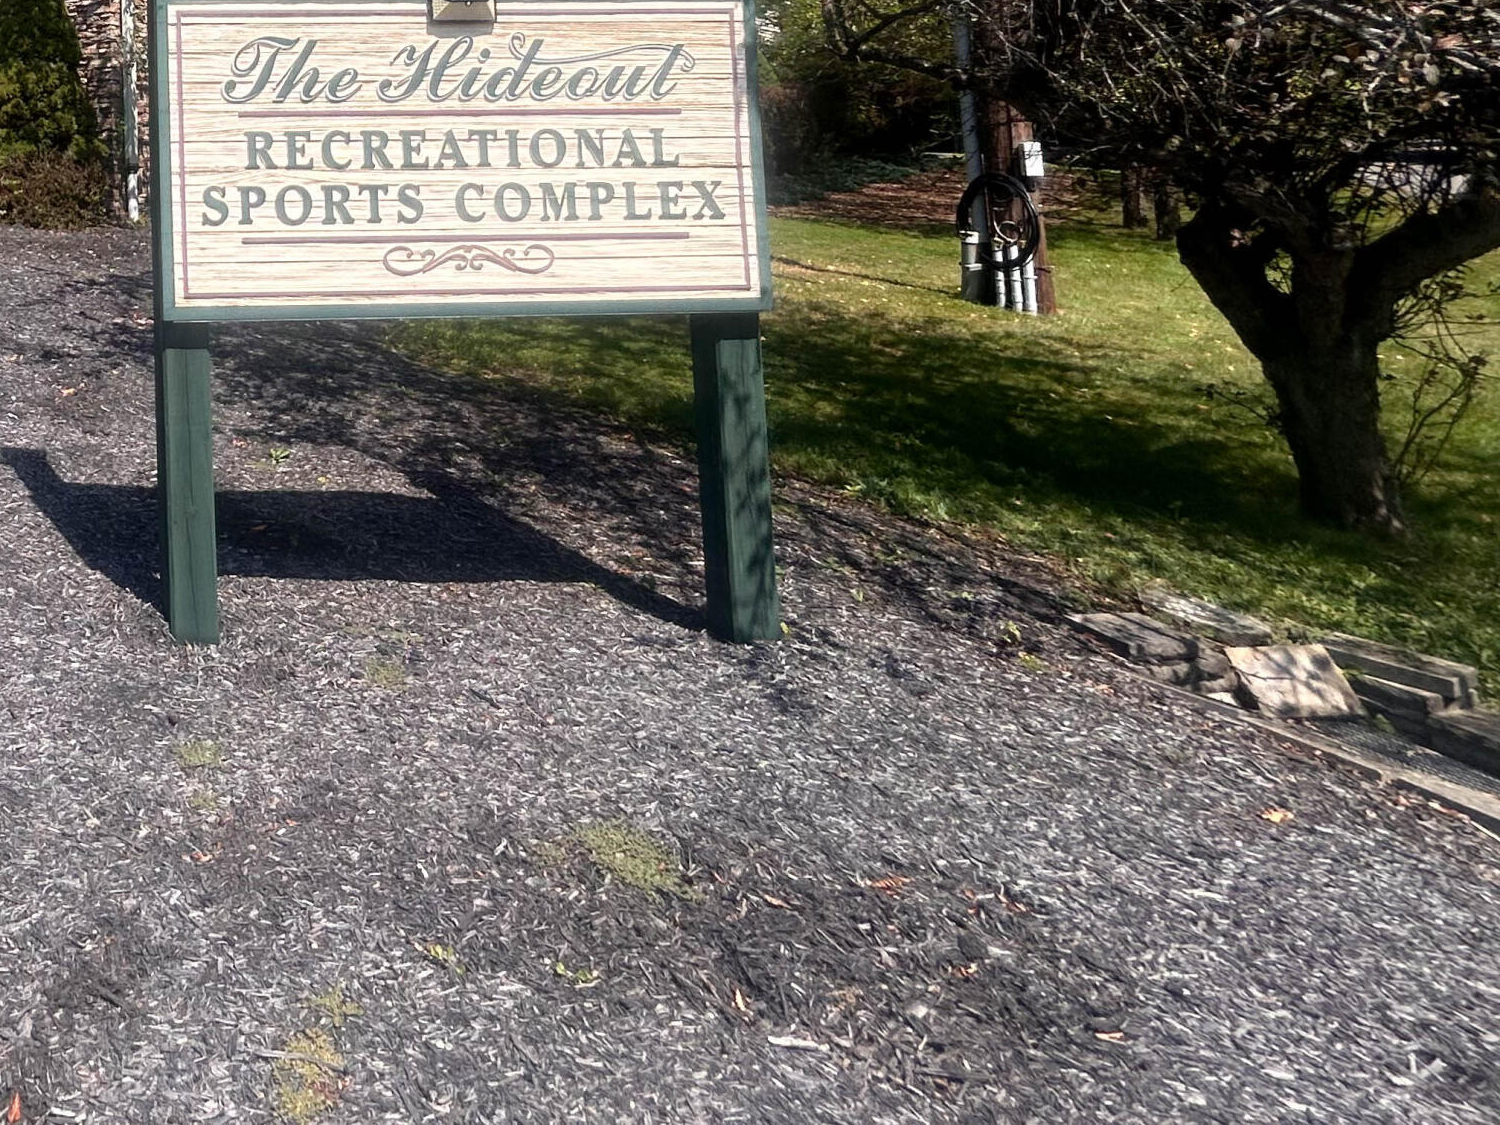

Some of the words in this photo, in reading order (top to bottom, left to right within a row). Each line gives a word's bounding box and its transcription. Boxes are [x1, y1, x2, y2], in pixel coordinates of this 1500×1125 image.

[222, 35, 360, 104] The
[375, 33, 696, 102] Hideout
[244, 128, 681, 170] RECREATIONAL
[201, 182, 425, 226] SPORTS
[454, 179, 727, 223] COMPLEX
